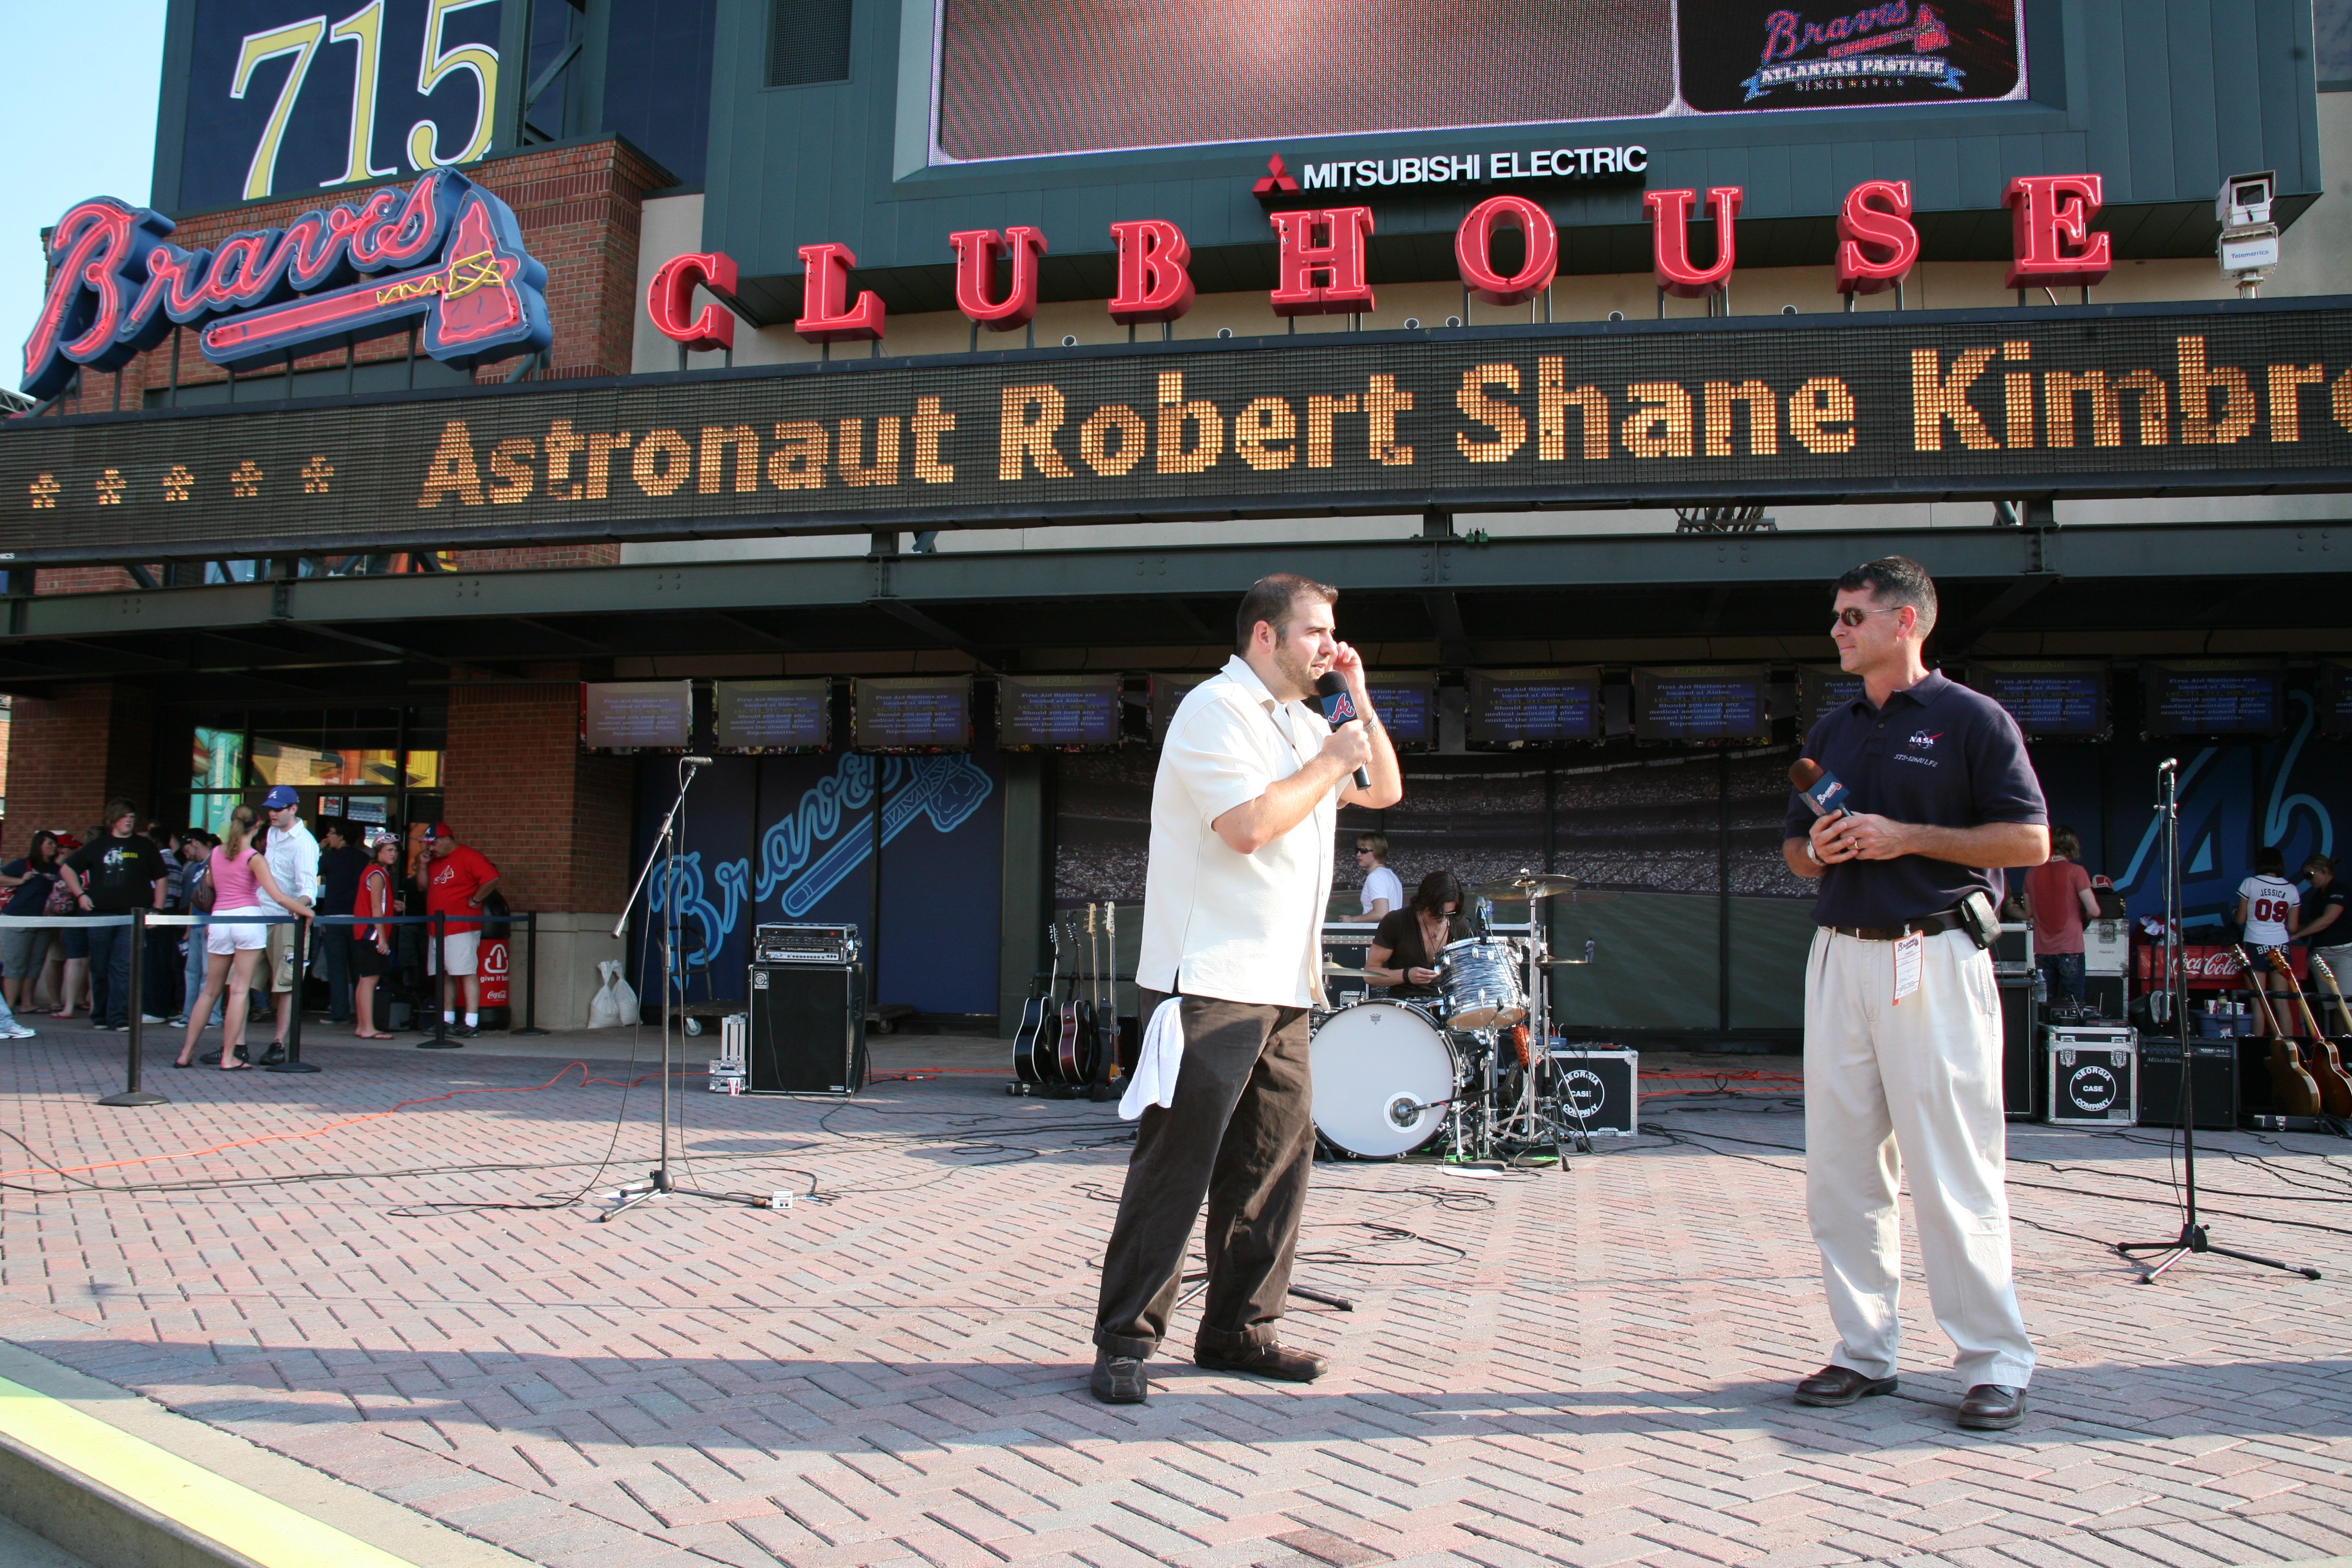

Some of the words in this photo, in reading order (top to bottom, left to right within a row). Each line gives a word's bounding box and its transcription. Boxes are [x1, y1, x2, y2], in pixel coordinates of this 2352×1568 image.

[1761, 0, 1910, 62] Braves
[230, 0, 499, 200] 715
[1304, 153, 1480, 190] MITSUBISHI
[1489, 145, 1648, 179] ELECTRIC
[2231, 250, 2269, 259] Telemetrics
[20, 168, 458, 391] Braves
[418, 396, 957, 509] Astronaut
[998, 372, 1414, 481] Robert
[1456, 355, 1857, 465] Shane
[1909, 736, 1934, 745] NASA
[2260, 888, 2286, 899] JESSICA
[2255, 899, 2289, 922] 09
[2075, 1067, 2111, 1082] GEORGIA
[2075, 1097, 2111, 1110] COMPANY
